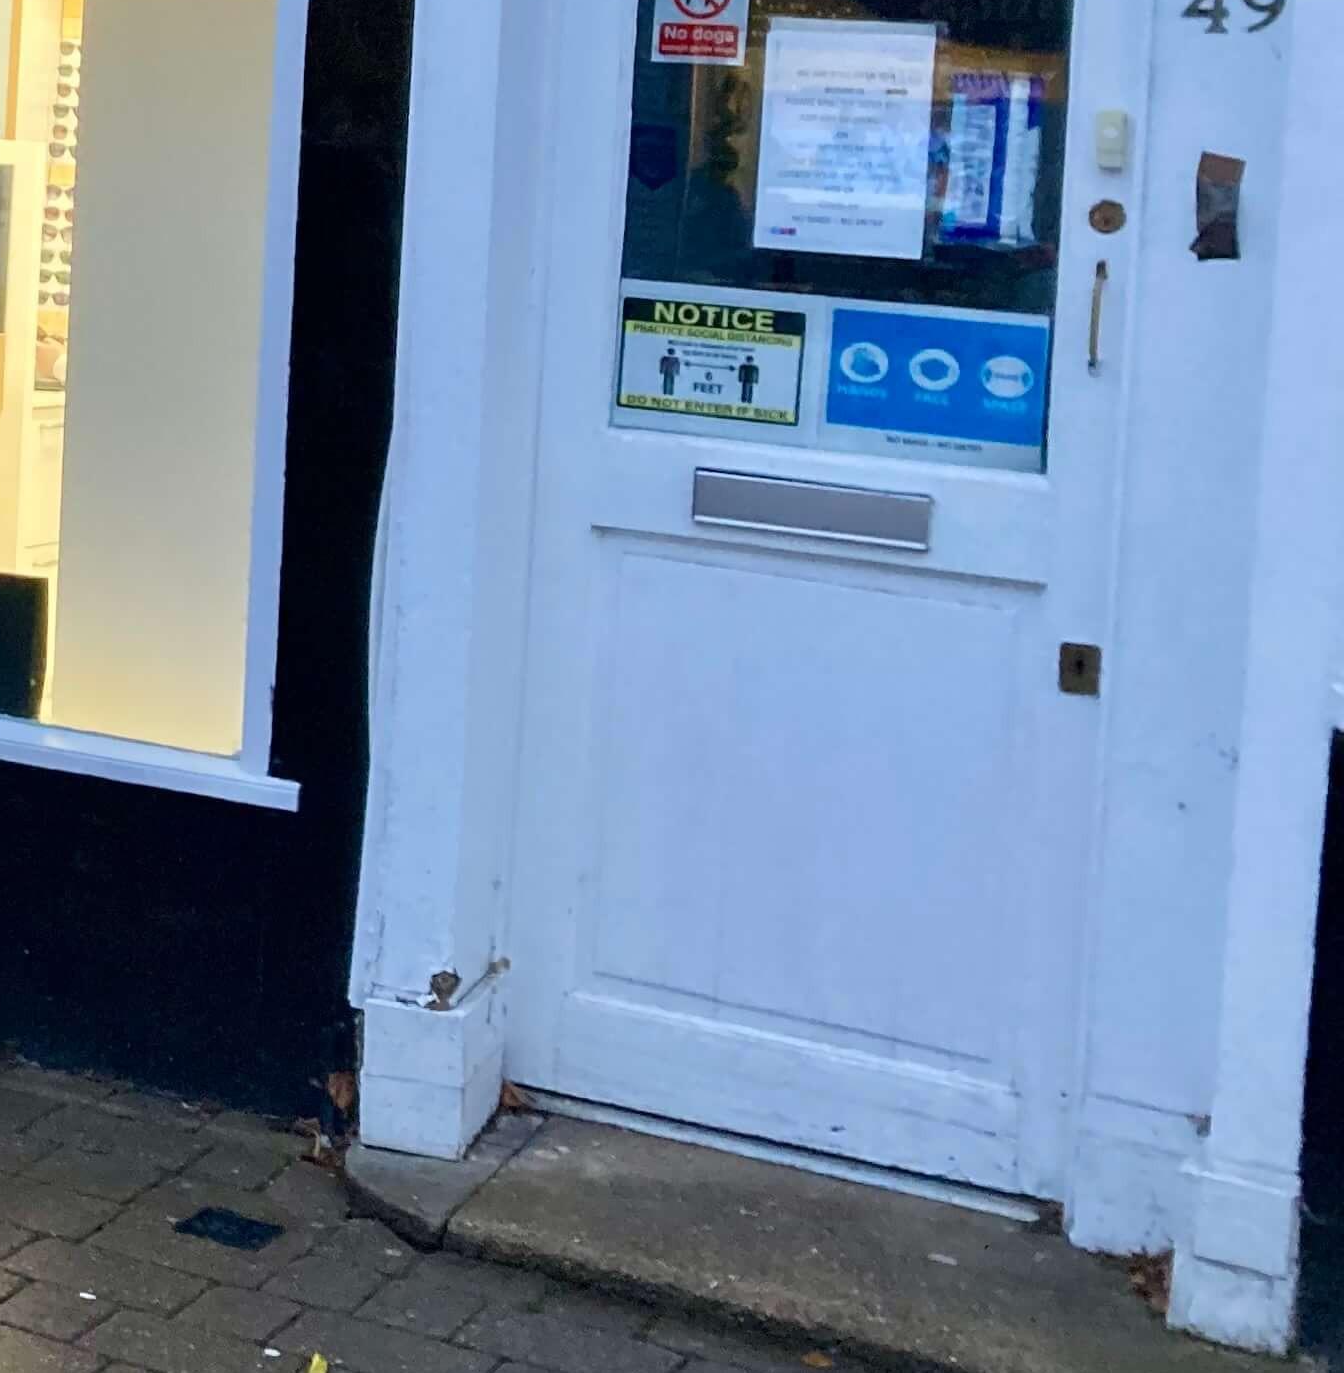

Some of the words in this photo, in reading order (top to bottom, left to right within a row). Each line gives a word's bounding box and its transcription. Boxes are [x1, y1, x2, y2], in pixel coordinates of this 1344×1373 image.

[664, 26, 688, 39] No
[692, 27, 734, 44] dogs
[654, 302, 774, 331] NOTICE
[634, 324, 683, 336] PRACTICE
[687, 328, 726, 340] SOCIAL
[693, 382, 723, 394] FEET
[627, 395, 647, 405] DO
[651, 397, 680, 408] NOT
[685, 400, 732, 415] ENTER
[736, 406, 750, 415] IF
[754, 408, 788, 420] SICK
